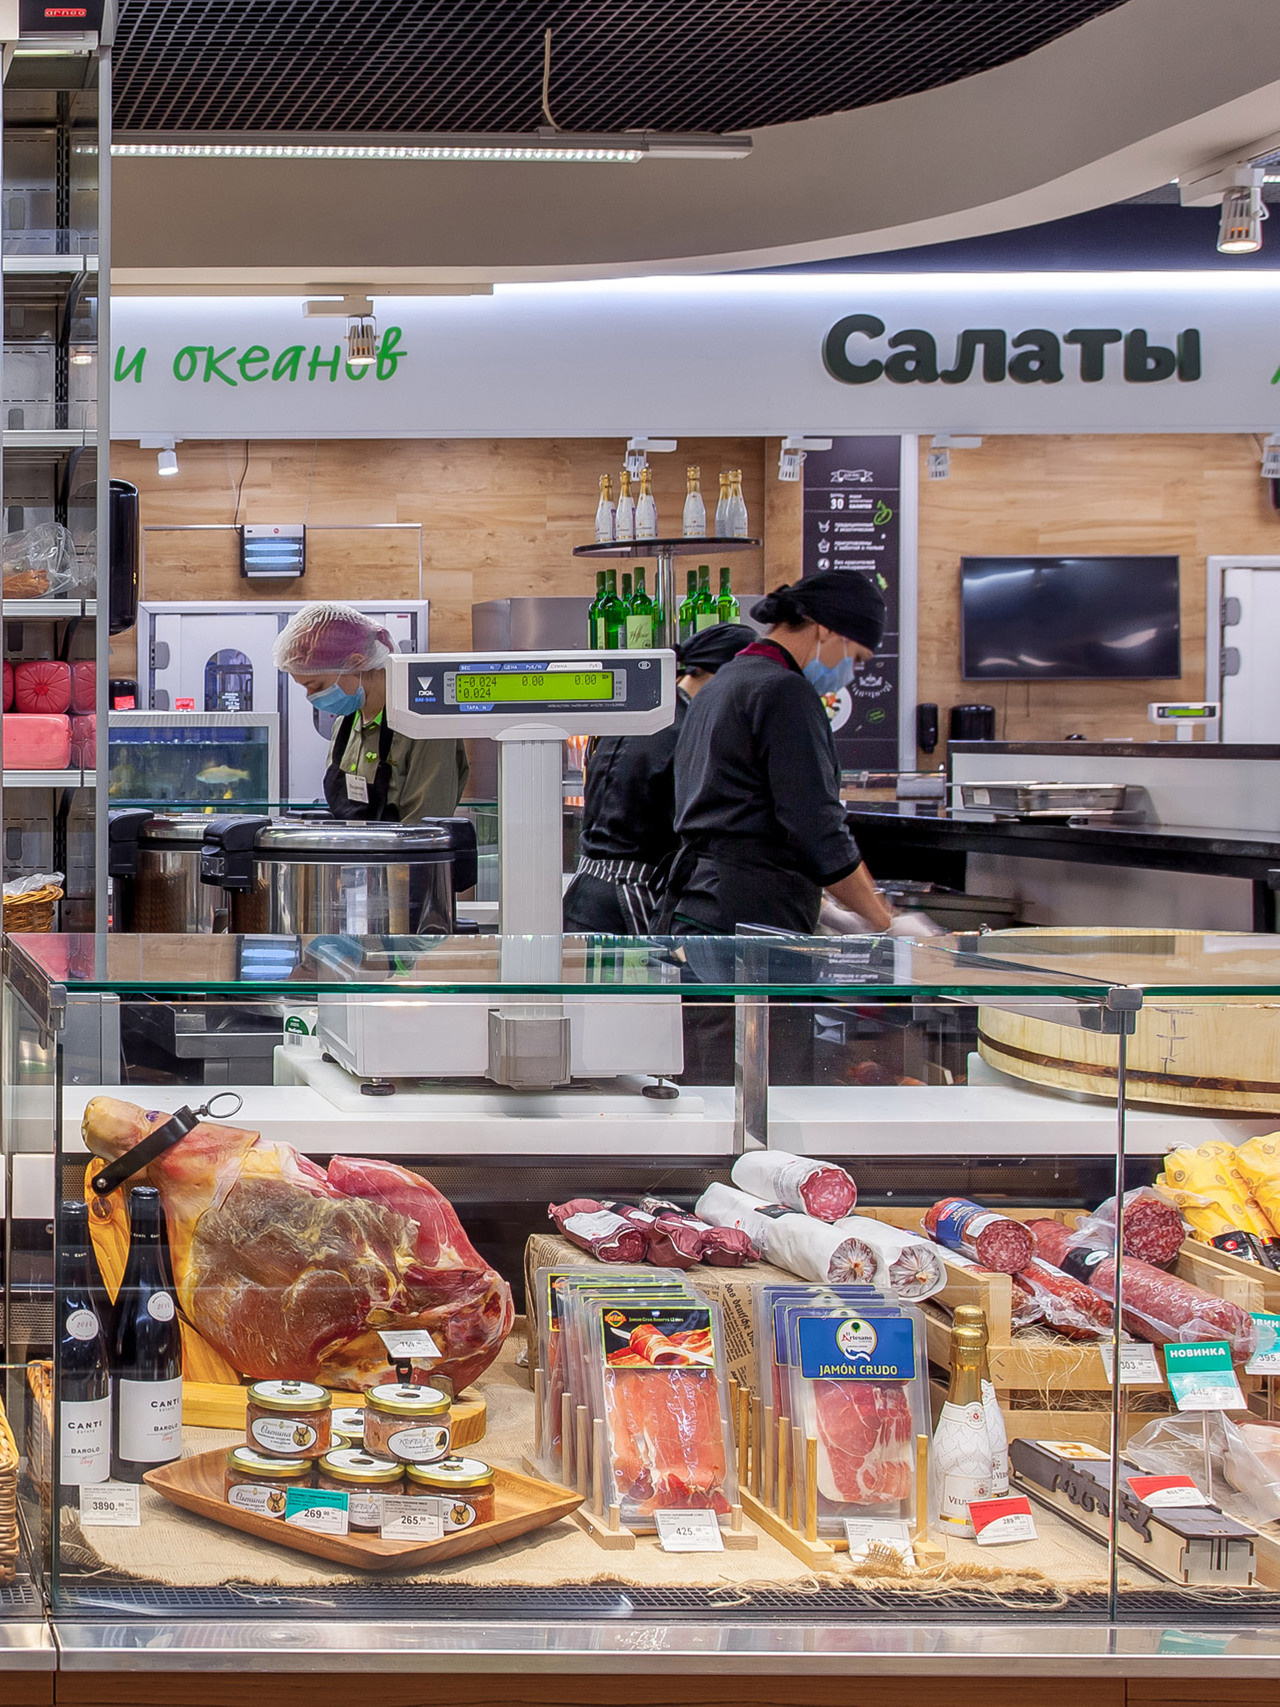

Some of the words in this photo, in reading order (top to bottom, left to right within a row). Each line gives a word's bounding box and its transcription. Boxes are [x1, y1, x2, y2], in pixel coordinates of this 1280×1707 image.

[822, 313, 1202, 385] Салаты
[114, 345, 148, 383] и
[830, 498, 844, 510] 30
[522, 675, 544, 687] 0.00
[574, 674, 597, 686] 0.00
[463, 687, 491, 699] 0.024
[1169, 1347, 1226, 1358] НОВИНКА
[819, 1362, 856, 1376] JAMÓN
[859, 1365, 898, 1375] CRUDO
[150, 1397, 180, 1409] CANTI
[67, 1420, 102, 1430] CANTI
[153, 1422, 178, 1432] BAROLO
[70, 1446, 101, 1454] BAROLO
[92, 1501, 118, 1511] 3890.
[303, 1507, 324, 1520] 269.
[400, 1514, 421, 1526] 265.
